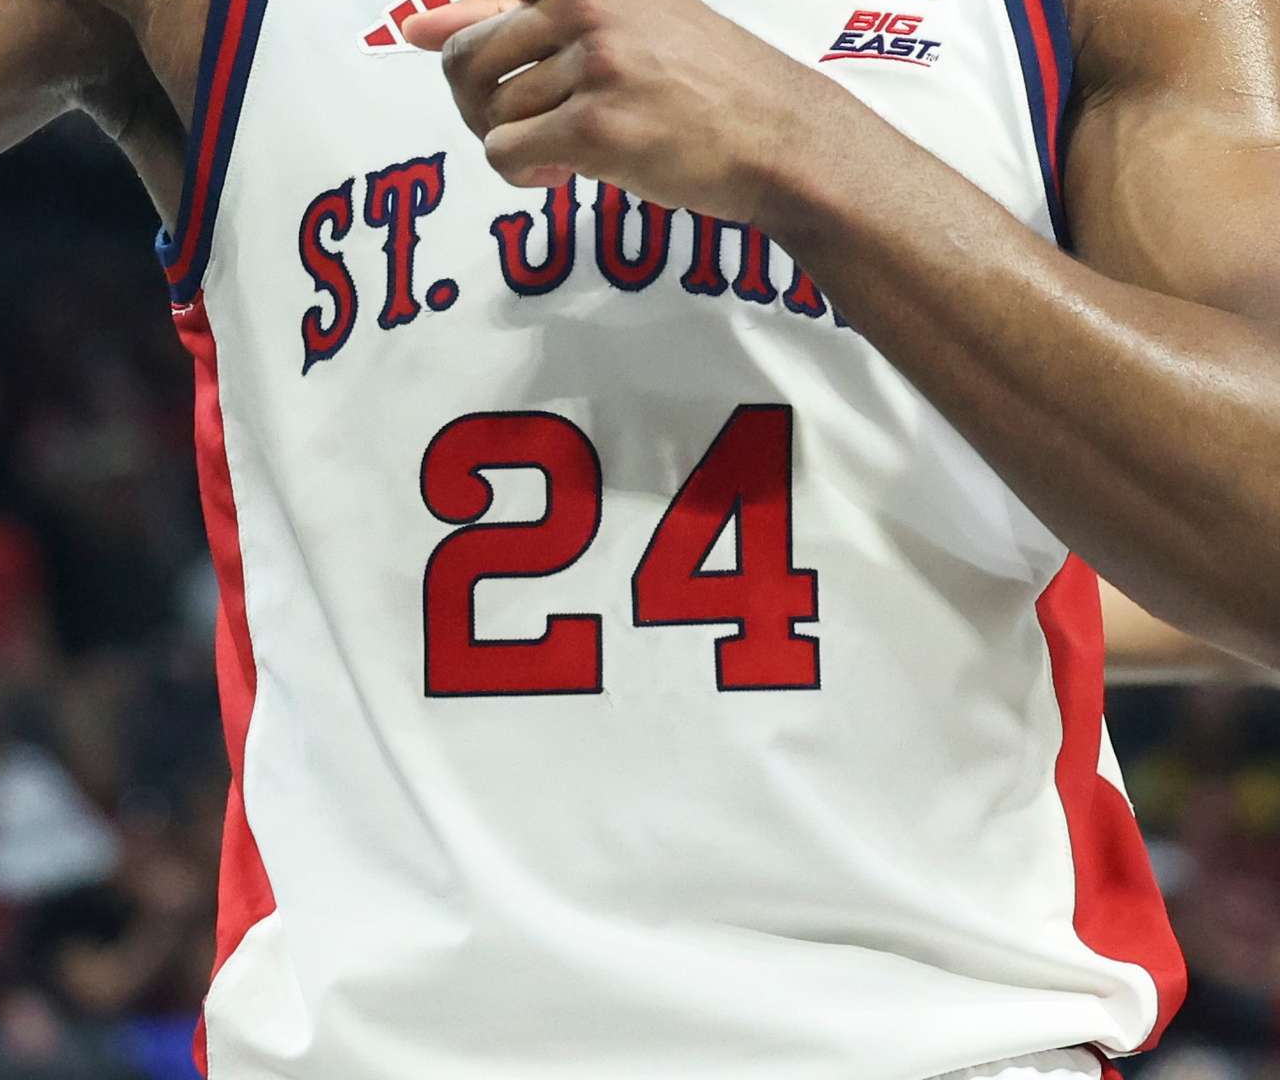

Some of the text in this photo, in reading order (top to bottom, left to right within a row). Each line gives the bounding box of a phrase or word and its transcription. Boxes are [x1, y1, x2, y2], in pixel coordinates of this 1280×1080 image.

[829, 31, 942, 60] EAST
[843, 9, 924, 36] BIG
[298, 151, 460, 377] ST.
[419, 403, 822, 698] 24
